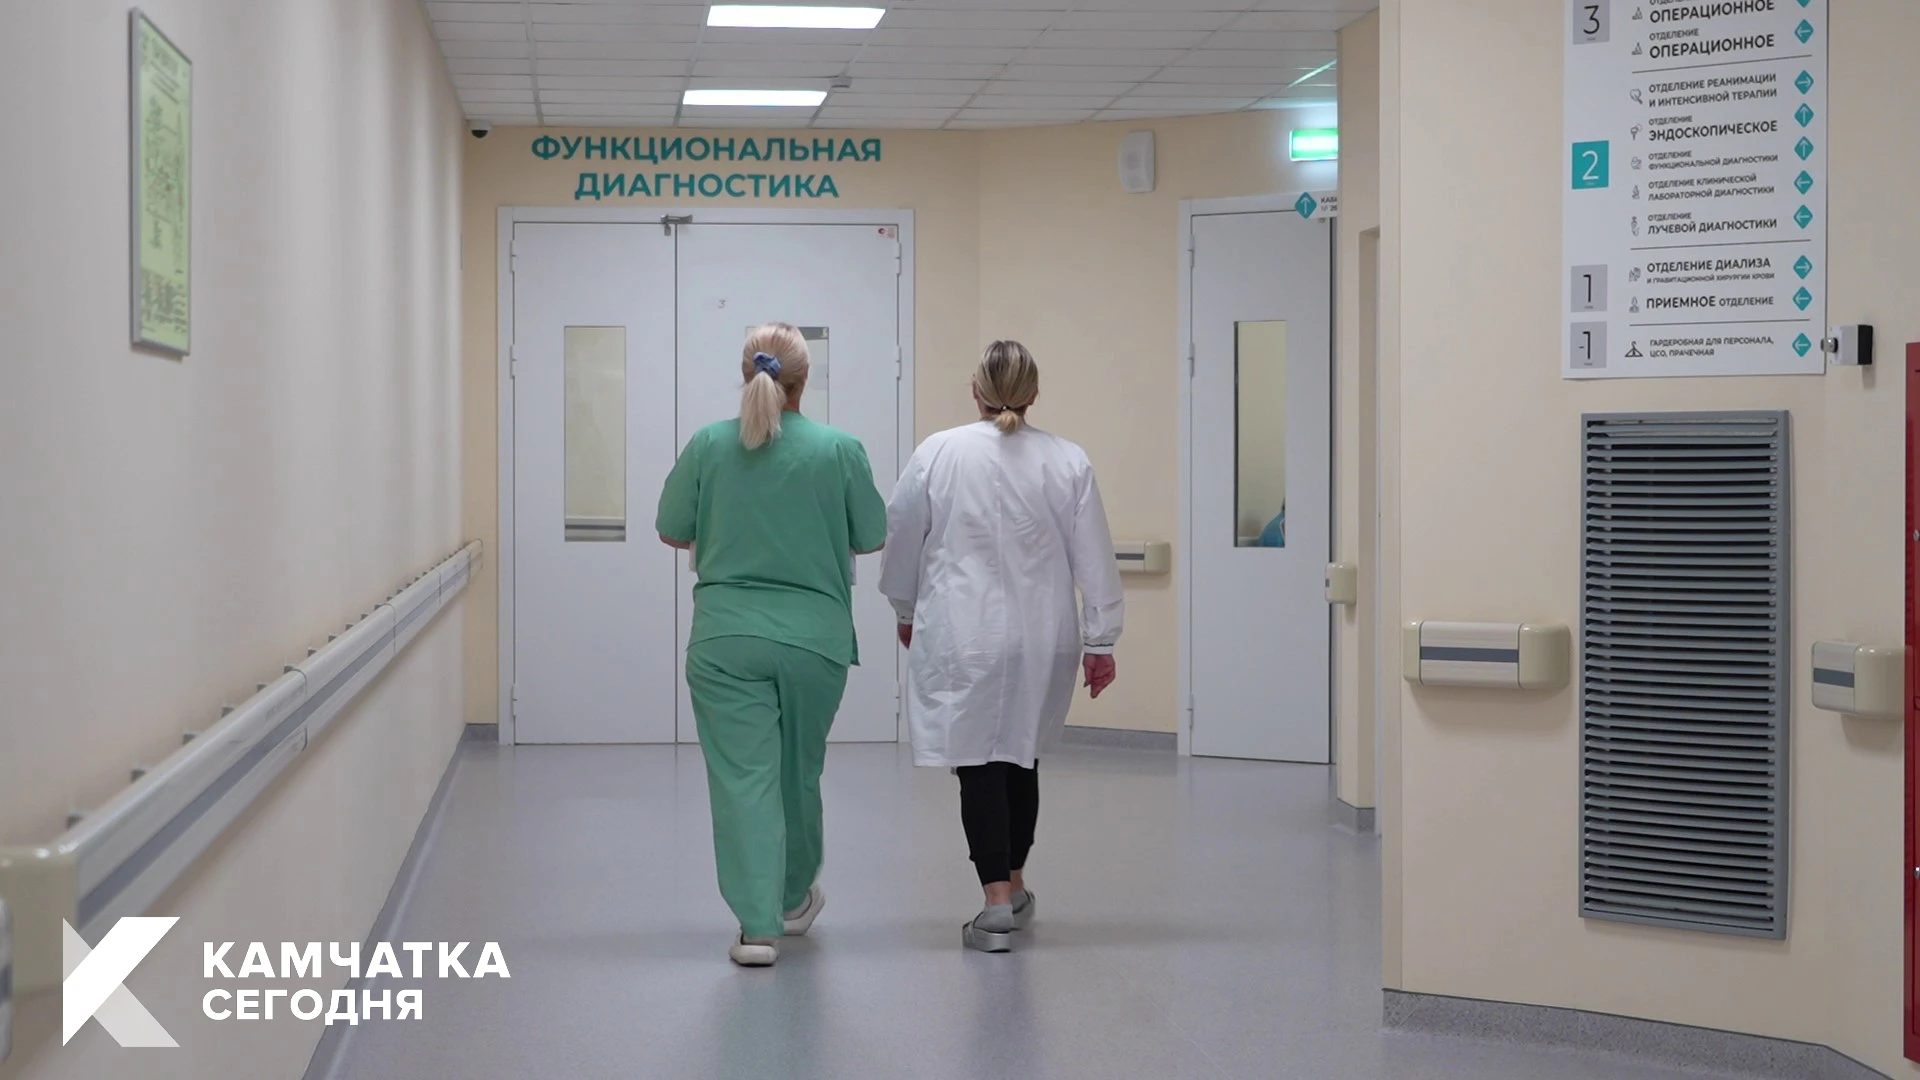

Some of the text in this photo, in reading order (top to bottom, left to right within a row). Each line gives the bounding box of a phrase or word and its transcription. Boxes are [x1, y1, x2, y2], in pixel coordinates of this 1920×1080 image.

[1650, 0, 1775, 23] ОПЕРАЦИОННОЕ
[1583, 5, 1600, 35] 3
[1649, 28, 1699, 41] ОТДЕЛЕНИЕ
[1649, 34, 1775, 58] ОПЕРАЦИОННОЕ
[1649, 73, 1777, 93] ОТДЕЛЕНИЕ РЕАНИМАЦИИ
[1658, 91, 1729, 106] ИНТЕНСИВНОЙ
[1732, 88, 1777, 100] ТЕРАПИИ
[1648, 115, 1693, 126] ОТДЕЛЕНИЕ
[1649, 120, 1778, 142] ЭНДОСКОПИЧЕСКОЕ
[531, 135, 882, 164] ФУНКЦИОНАЛЬНАЯ
[1648, 150, 1692, 160] ОТДЕЛЕНИЕ
[1582, 150, 1599, 181] 2
[1648, 154, 1778, 170] ФУНКЦИОНАЛЬНОЙ ДИАГНОСТИКИ
[574, 173, 840, 200] ДИАГНОСТИКА
[1648, 173, 1757, 189] ОТДЕЛЕНИЕ КЛИНИЧЕСКОЙ
[1648, 186, 1775, 201] ЛАБОРАТОРНОЙ ДИАГНОСТИКИ
[1648, 212, 1692, 222] ОТДЕЛЕНИЕ
[1648, 219, 1777, 235] ЛУЧЕВОЙ ДИАГНОСТИКИ
[1647, 257, 1771, 273] ОТДЕЛЕНИЕ ДИАЛИЗА
[1653, 274, 1715, 284] ГРАВИТАЦИОННОЙ
[1582, 274, 1591, 302] 1
[1646, 296, 1774, 309] ПРИЕМНОЕ ОТДЕЛЕНИЕ
[1650, 336, 1774, 347] ГАРДЕРОБНАЯ ДЛЯ ПЕРСОНАЛА,
[1650, 348, 1715, 358] ЦСО, ПРАЧЕЧНАЯ
